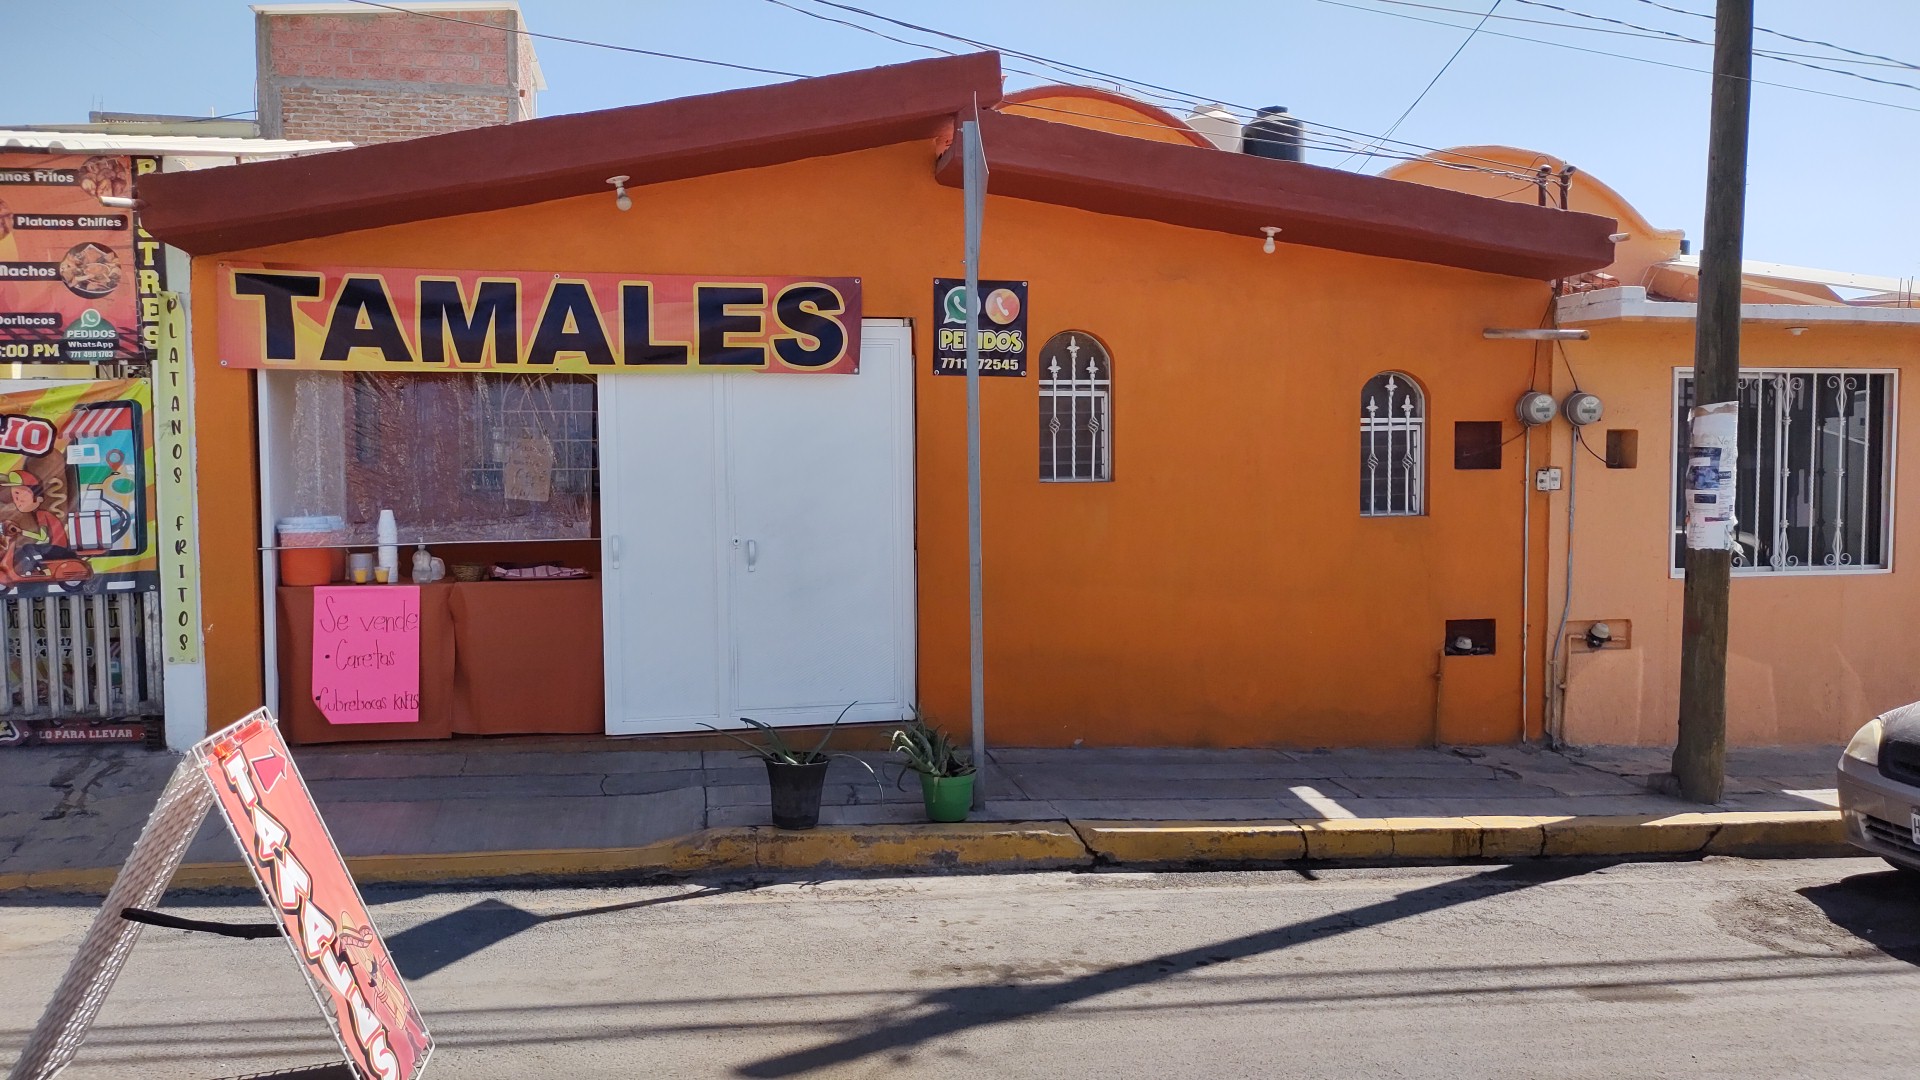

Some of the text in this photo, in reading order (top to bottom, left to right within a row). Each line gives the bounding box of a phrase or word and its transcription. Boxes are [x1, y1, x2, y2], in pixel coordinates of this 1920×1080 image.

[33, 171, 74, 183] Fritos
[17, 216, 122, 227] Platanos Chifles
[232, 271, 847, 369] TAMALES
[66, 329, 116, 338] PEDIDOS
[67, 340, 114, 349] WhatsApp
[939, 328, 1023, 353] PEIDOS
[33, 343, 60, 357] PM
[940, 357, 1019, 370] 771172545
[319, 595, 418, 633] Se vende
[335, 638, 397, 671] Caretas
[318, 686, 387, 712] Cubrebocas
[54, 729, 86, 739] PARA
[88, 729, 133, 739] LLEVAR
